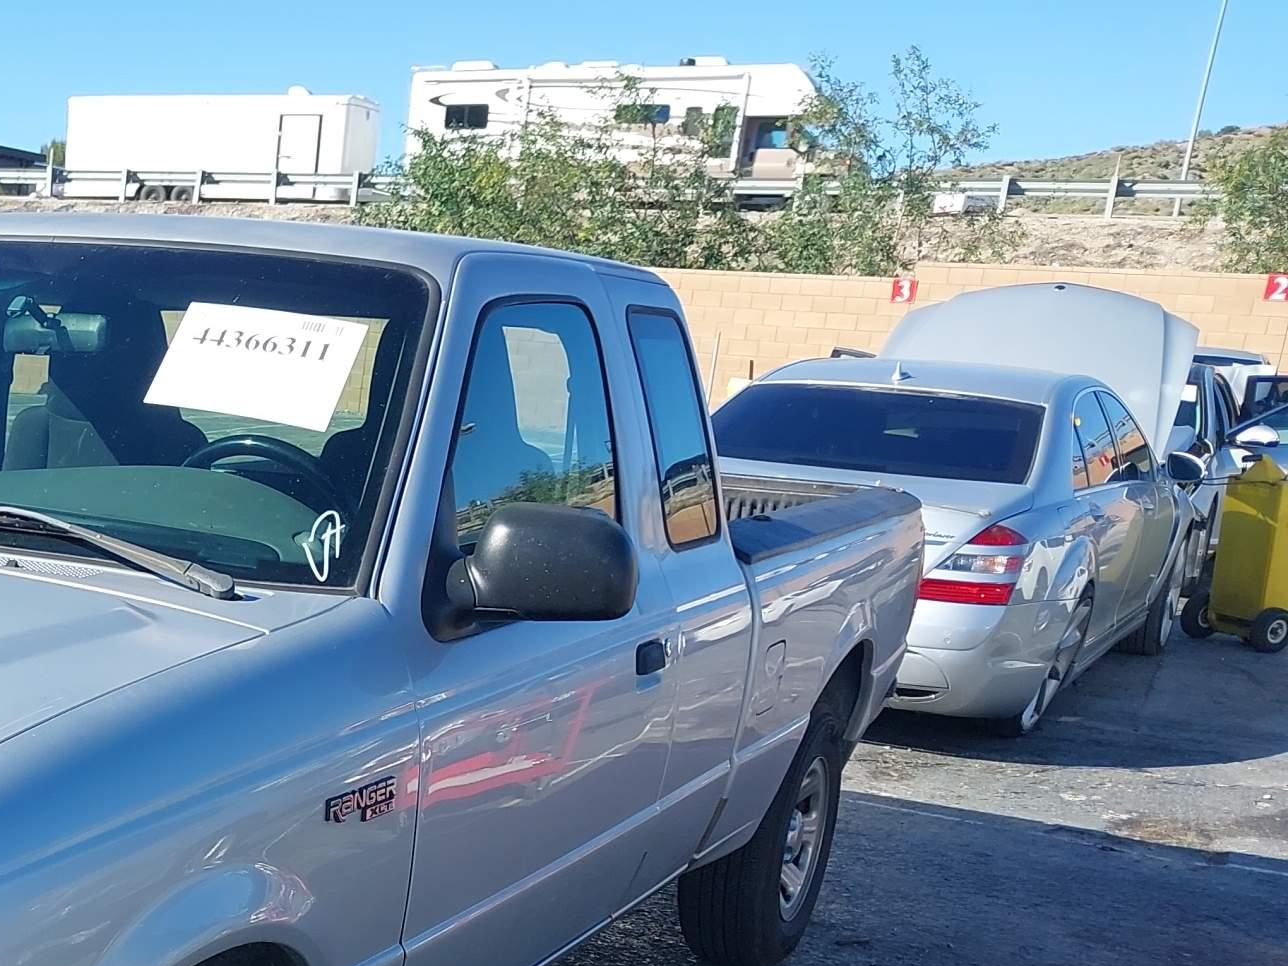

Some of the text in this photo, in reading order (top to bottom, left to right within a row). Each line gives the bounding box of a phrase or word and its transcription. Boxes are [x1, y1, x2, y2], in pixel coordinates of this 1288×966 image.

[896, 280, 911, 302] 3
[1270, 276, 1288, 301] 2
[192, 327, 331, 361] 44366311
[325, 777, 397, 822] RANGER
[368, 801, 393, 818] XLT
